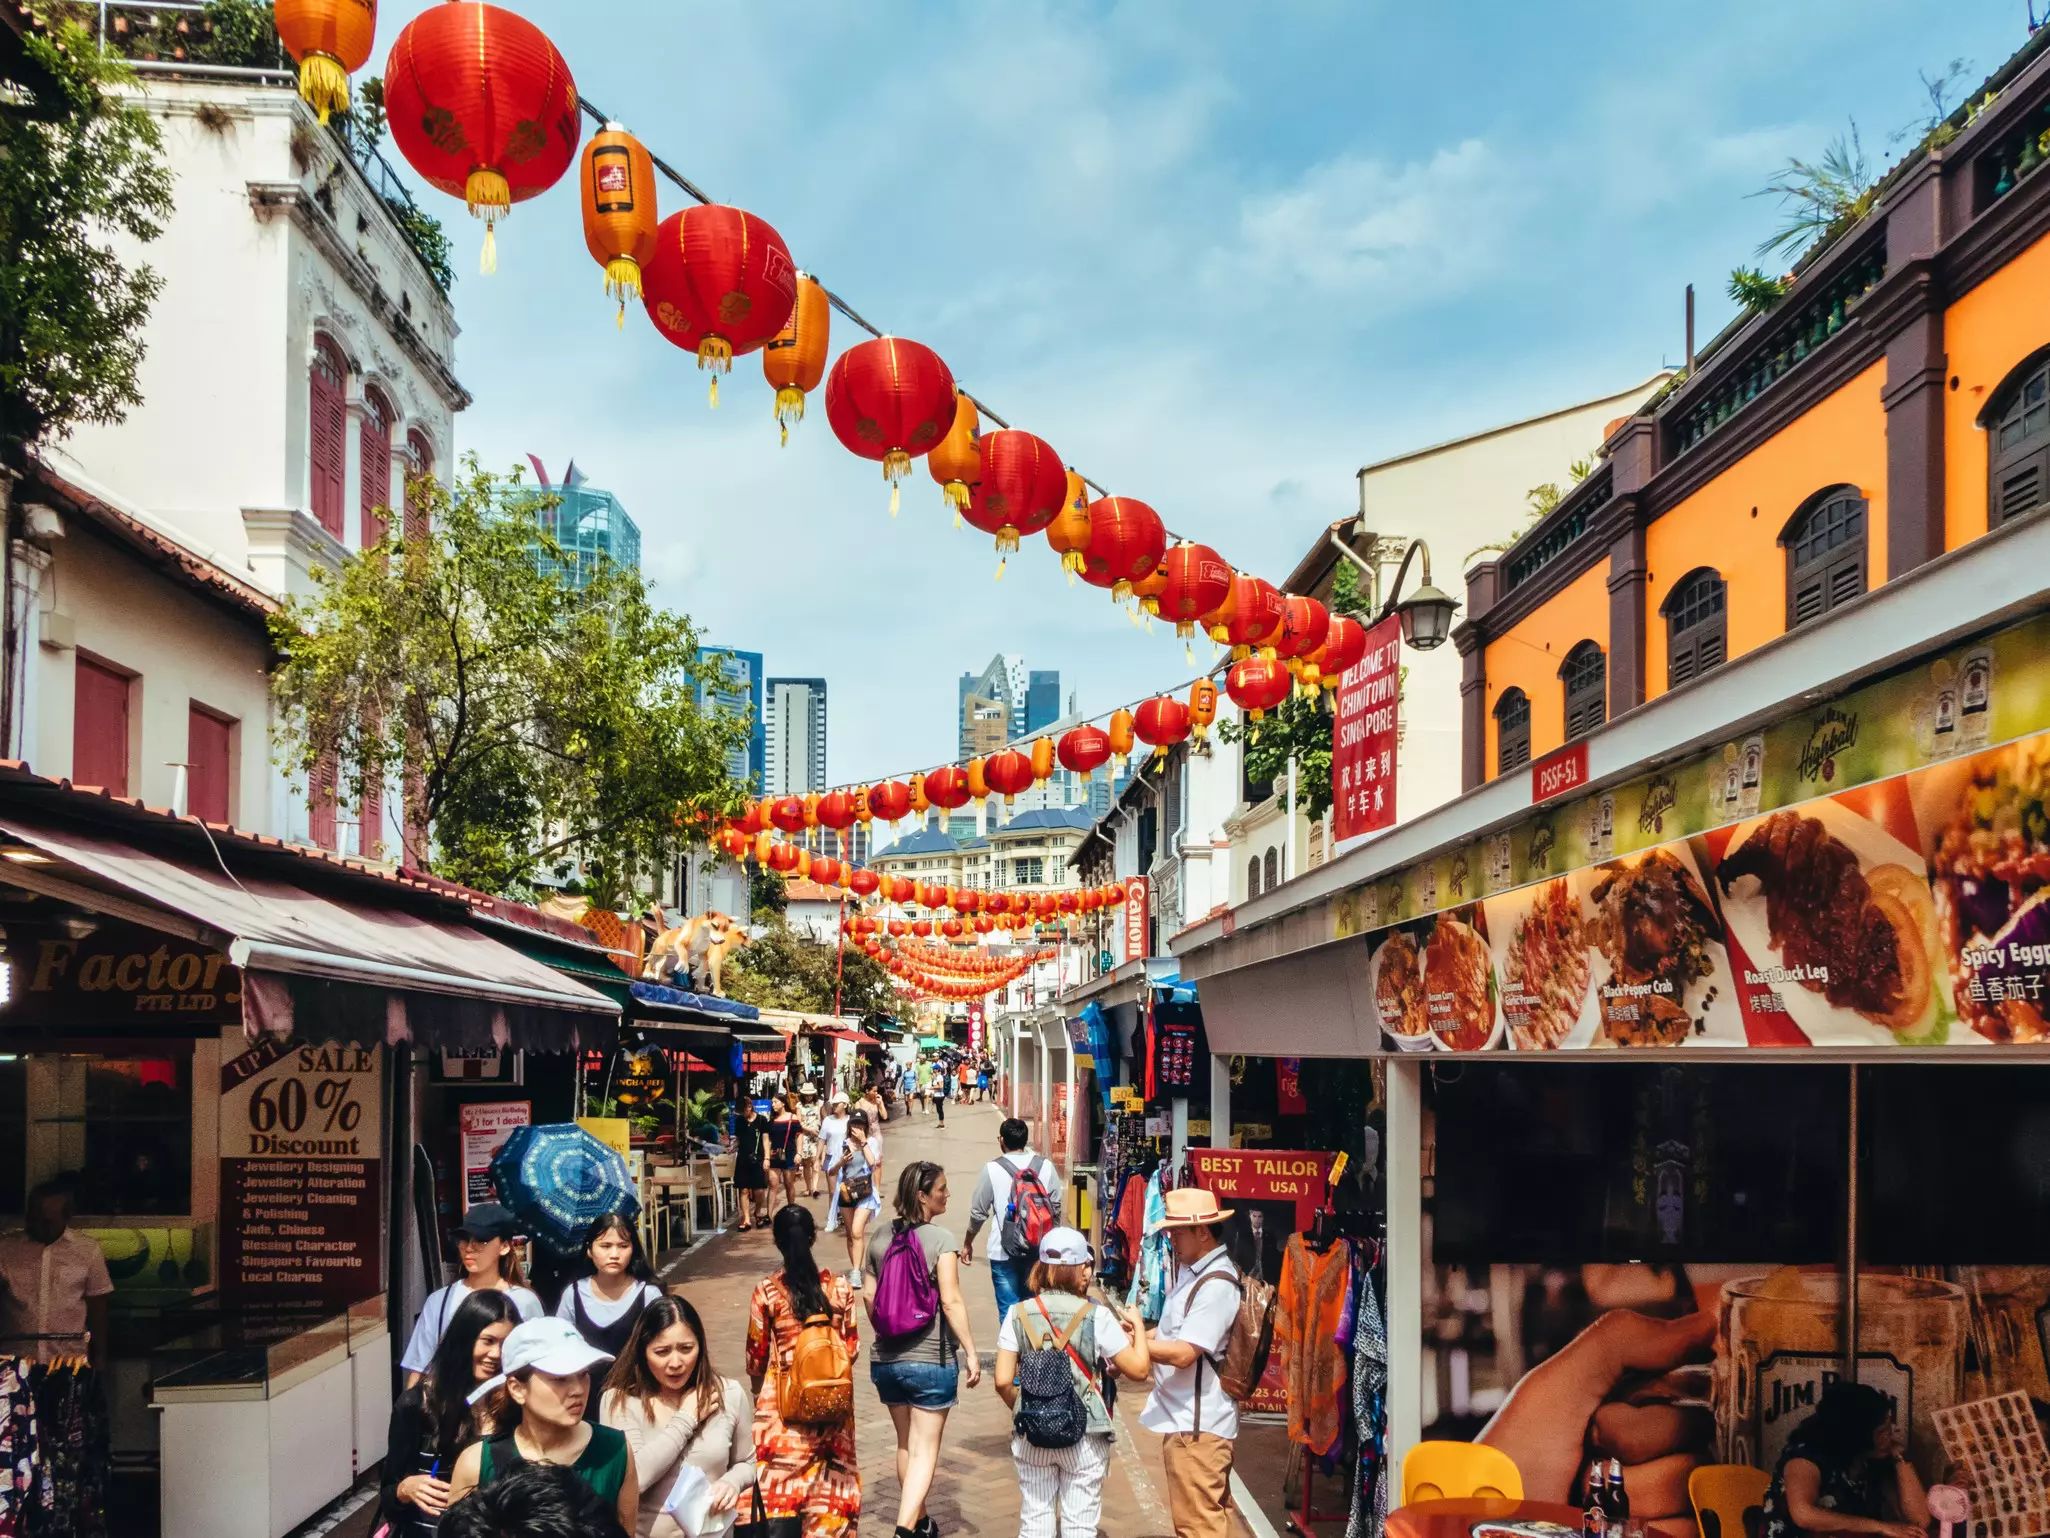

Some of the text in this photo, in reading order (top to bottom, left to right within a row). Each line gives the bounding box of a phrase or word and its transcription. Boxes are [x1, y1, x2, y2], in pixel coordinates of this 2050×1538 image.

[1341, 640, 1399, 690] WELCOME TO
[1796, 712, 1859, 783] Highball
[1541, 756, 1578, 794] PSSF-51
[1348, 785, 1384, 819] 牛车水
[1129, 882, 1145, 956] Canon
[1961, 945, 2005, 971] Spicy
[30, 940, 241, 1003] Factor
[1743, 963, 1829, 985] Roast Duck Leg
[1602, 978, 1674, 999] Black Pepper Crab
[1969, 974, 2045, 1001] 鱼香茄子
[134, 994, 217, 1011] PTE LTD
[233, 1043, 279, 1078] UP T
[299, 1048, 373, 1073] SALE
[250, 1077, 361, 1132] 60%
[250, 1134, 360, 1155] Discount
[244, 1161, 365, 1174] Jewellery Designing
[1201, 1157, 1243, 1173] BEST
[1254, 1160, 1318, 1176] TAILOR
[243, 1178, 366, 1190] Jewellery Alteration
[243, 1193, 357, 1205] Jewellery Cleaning
[243, 1208, 309, 1221] & Polishing
[242, 1224, 325, 1236] Jade, Chinese
[242, 1240, 357, 1252] Blessing Character
[242, 1256, 362, 1268] Singapore Favourite
[242, 1272, 323, 1283] Local Charms
[1764, 1379, 1815, 1423] JIM
